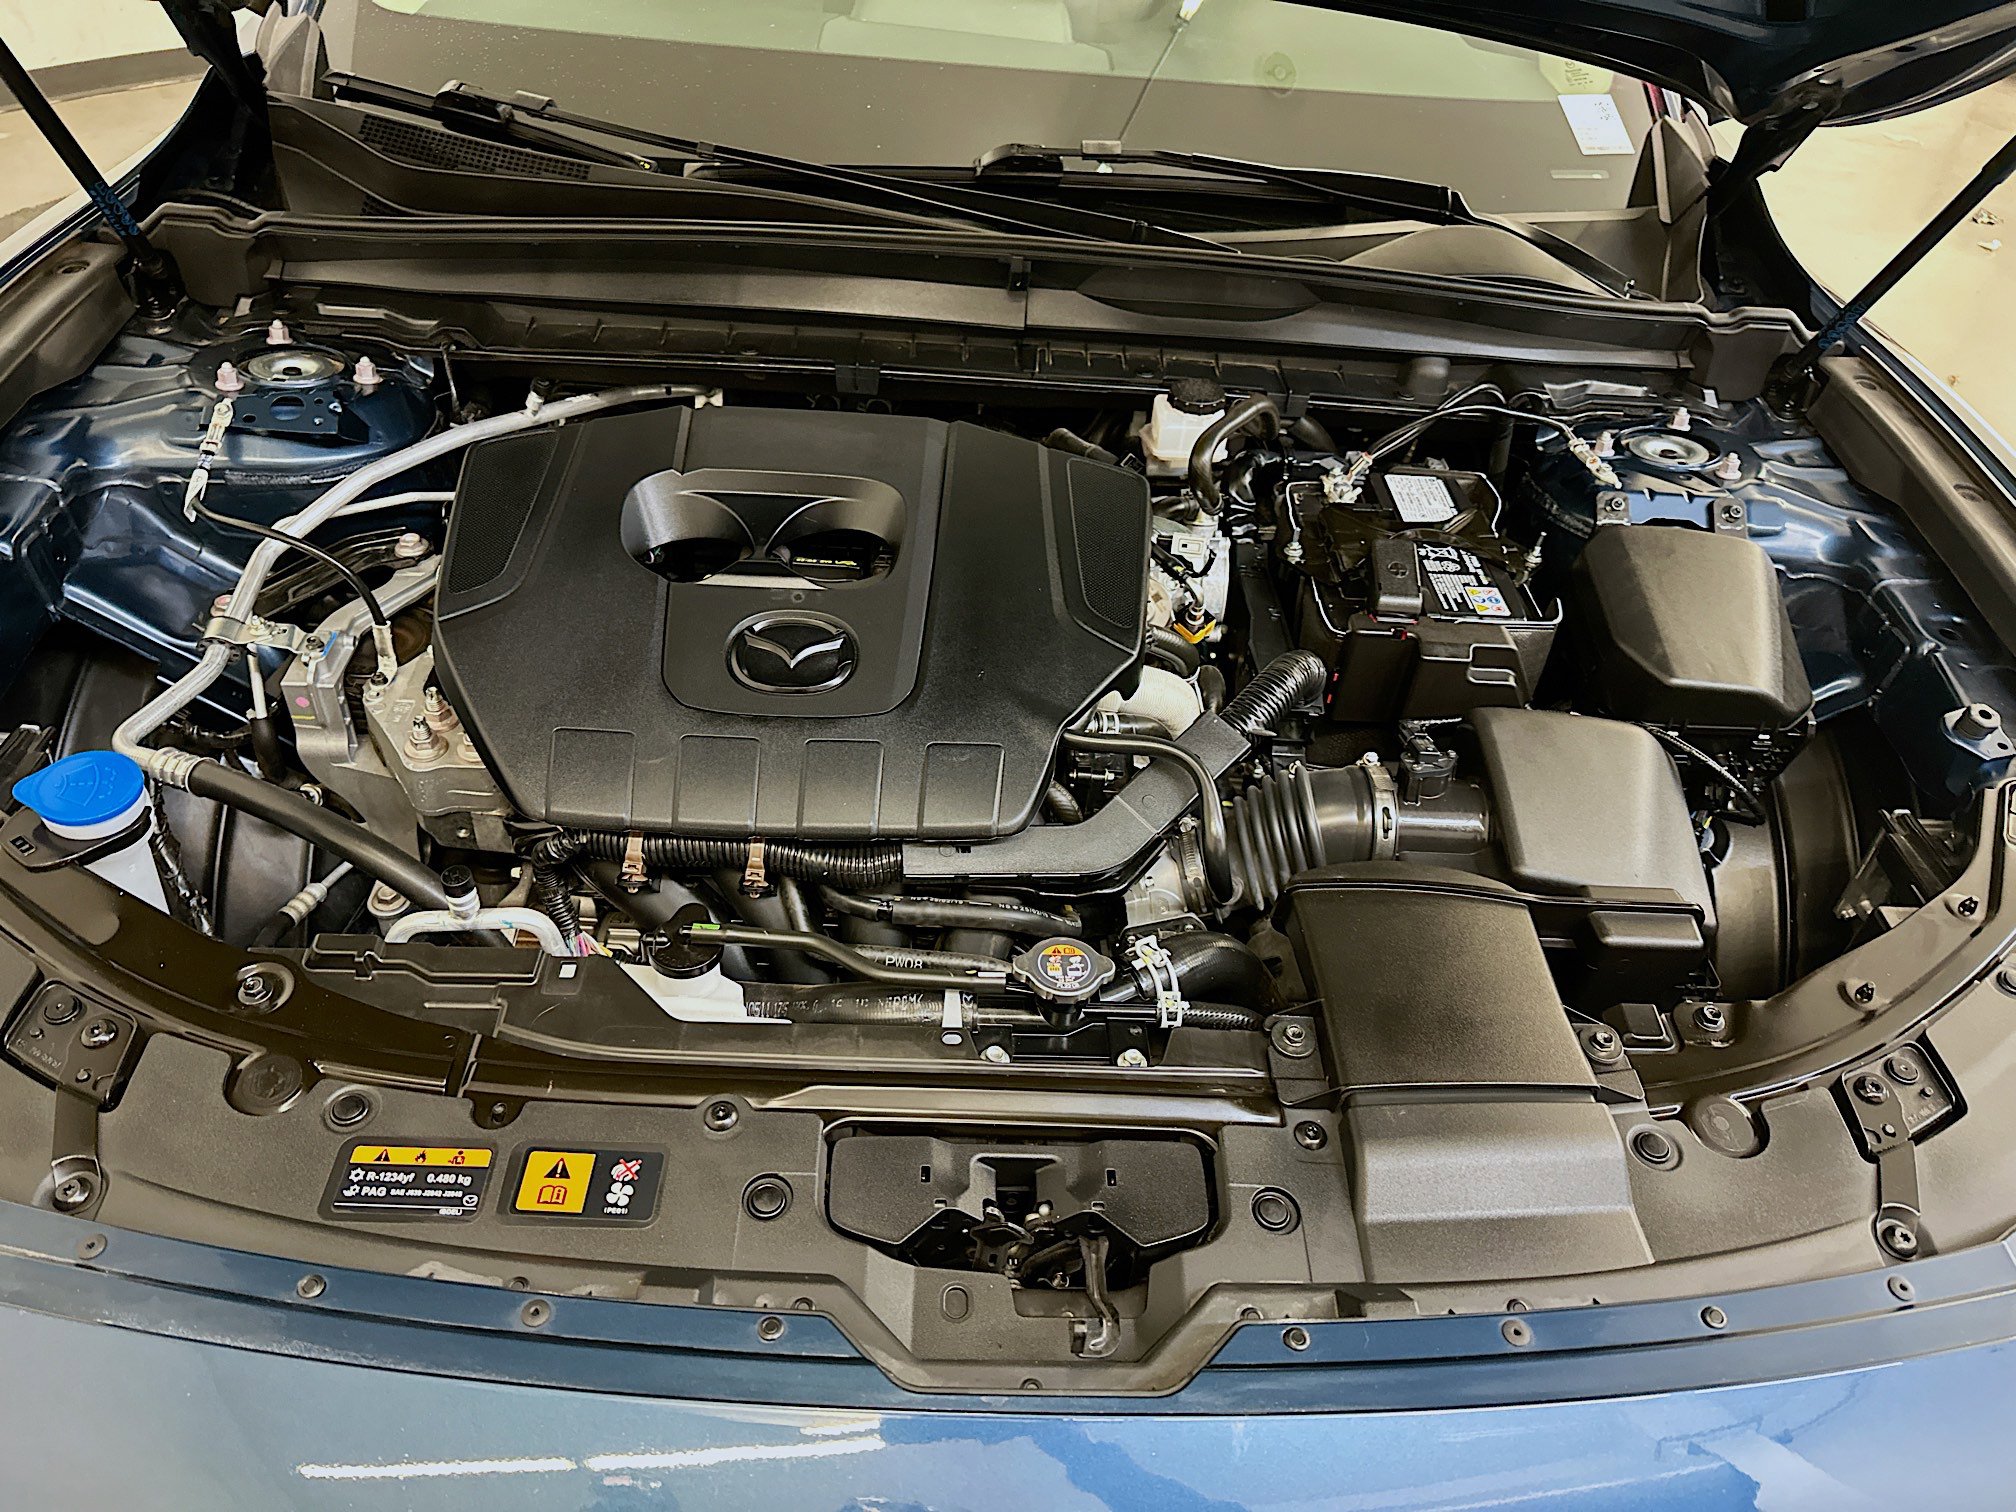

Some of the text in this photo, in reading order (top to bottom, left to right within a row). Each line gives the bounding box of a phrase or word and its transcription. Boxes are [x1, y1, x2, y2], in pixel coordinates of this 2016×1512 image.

[885, 955, 923, 969] PW08
[366, 1171, 416, 1184] R-1234yf
[457, 1174, 473, 1187] kg
[361, 1186, 387, 1197] PAG
